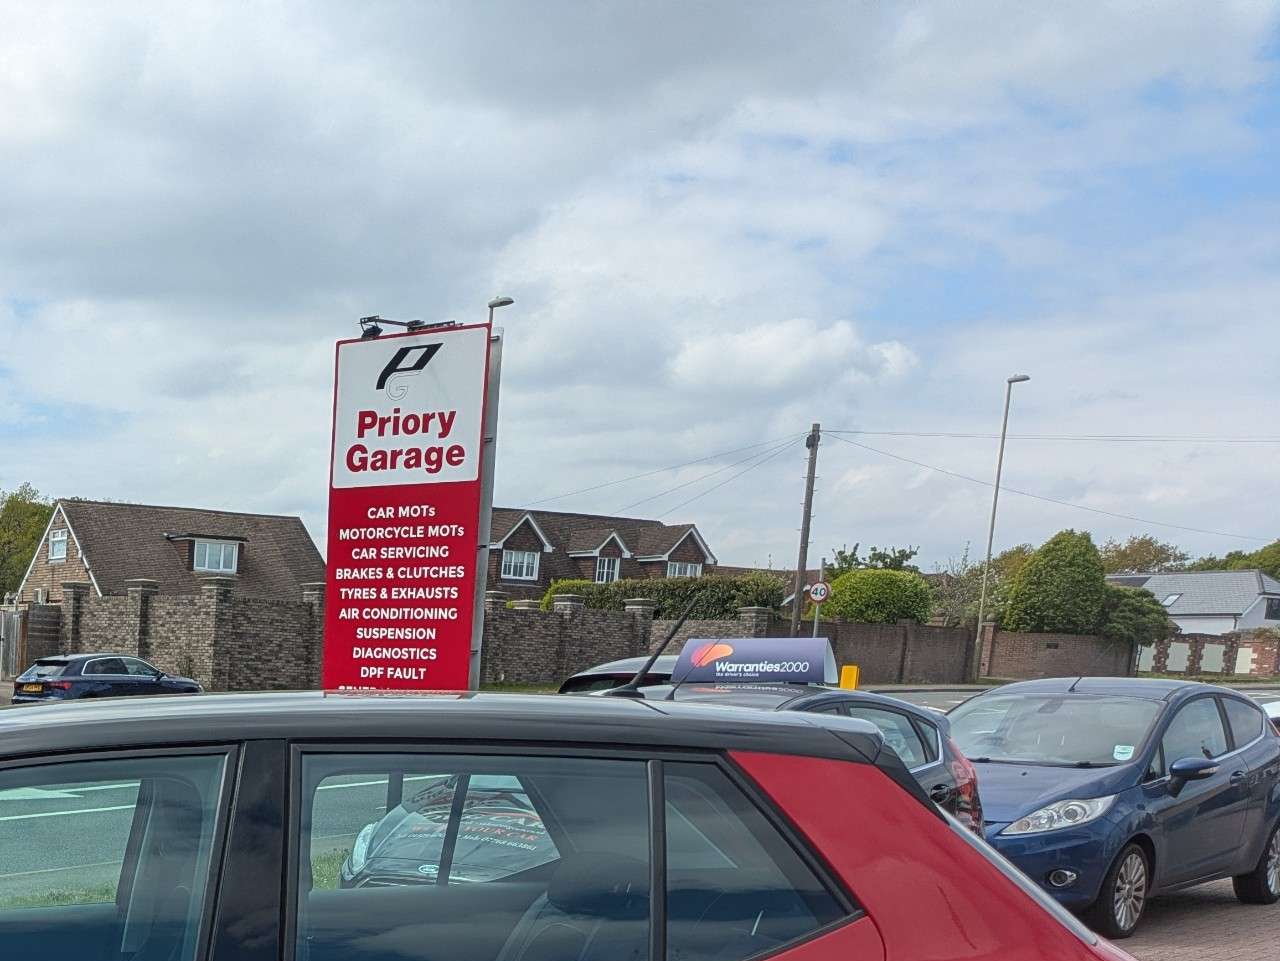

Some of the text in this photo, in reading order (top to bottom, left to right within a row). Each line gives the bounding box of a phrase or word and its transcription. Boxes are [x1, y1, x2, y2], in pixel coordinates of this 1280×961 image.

[357, 407, 457, 439] Priory
[346, 444, 466, 474] Garage
[367, 505, 436, 519] CAR MOTs
[339, 525, 464, 540] MOTORCYCLE MOTs
[351, 546, 449, 560] CAR SERVICING
[336, 566, 465, 580] BRAKES & CLUTCHES
[340, 586, 458, 599] TYRES & EXHAUSTS
[812, 587, 826, 597] 40
[339, 607, 458, 620] AIR CONDITIONING
[356, 627, 436, 640] SUSPENSION
[352, 647, 437, 660] DIAGNOSTICS
[360, 666, 426, 680] DPF FAULT
[715, 661, 810, 673] Warranties2000
